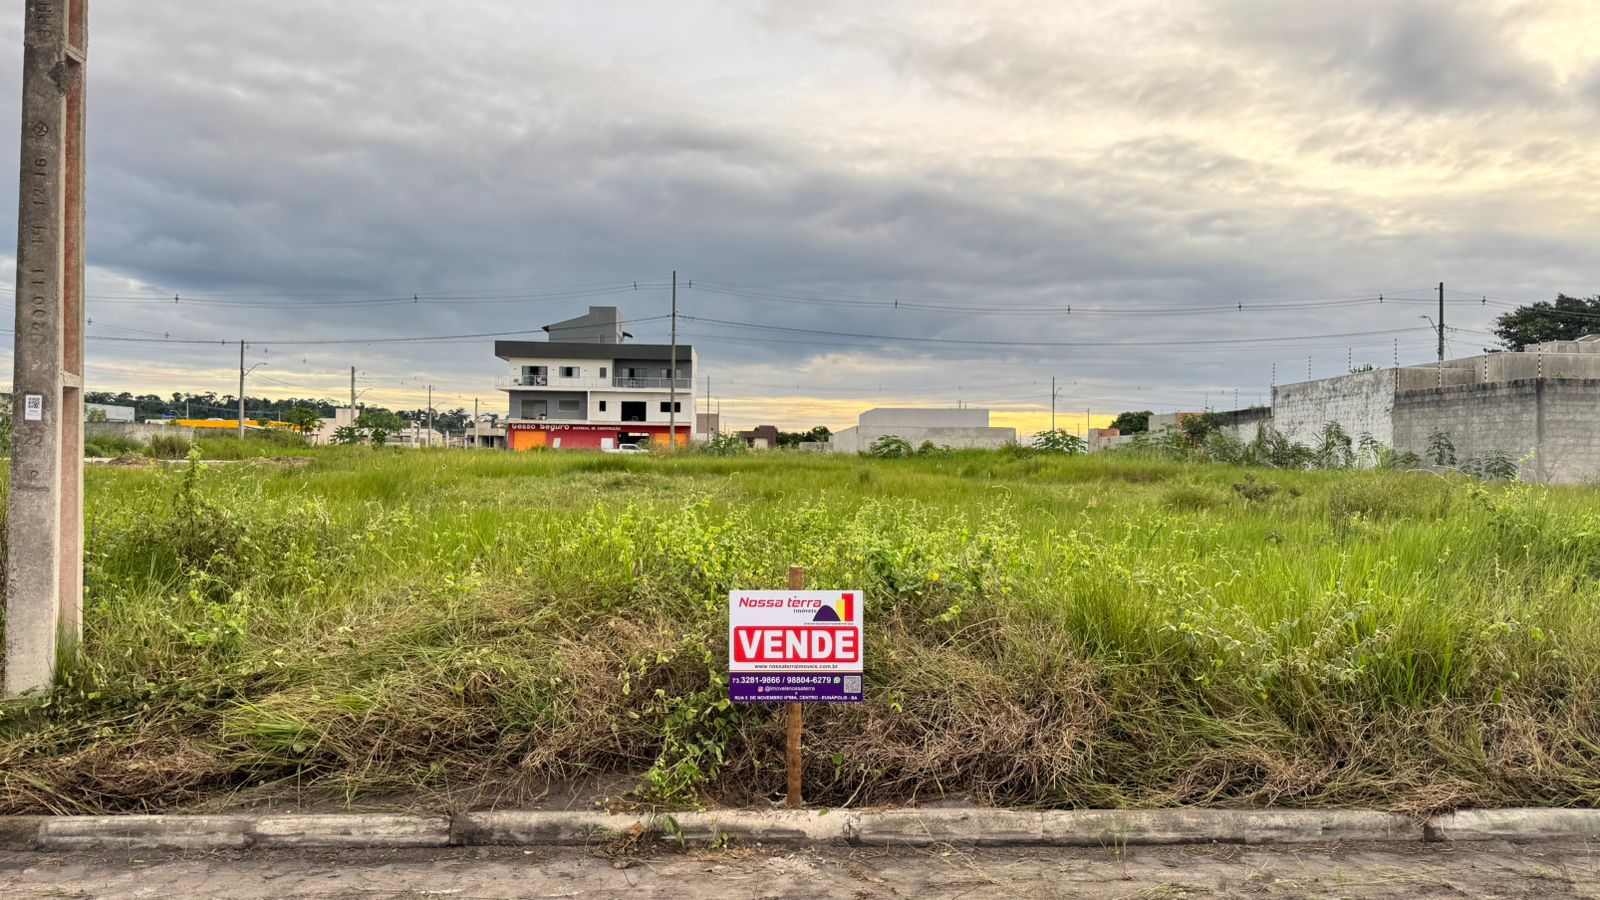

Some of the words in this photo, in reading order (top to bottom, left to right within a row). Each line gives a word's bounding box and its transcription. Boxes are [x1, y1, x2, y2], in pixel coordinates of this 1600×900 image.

[739, 597, 783, 608] Nossa
[787, 597, 822, 607] terra
[738, 630, 855, 659] VENDE
[787, 676, 831, 684] 98804-6279
